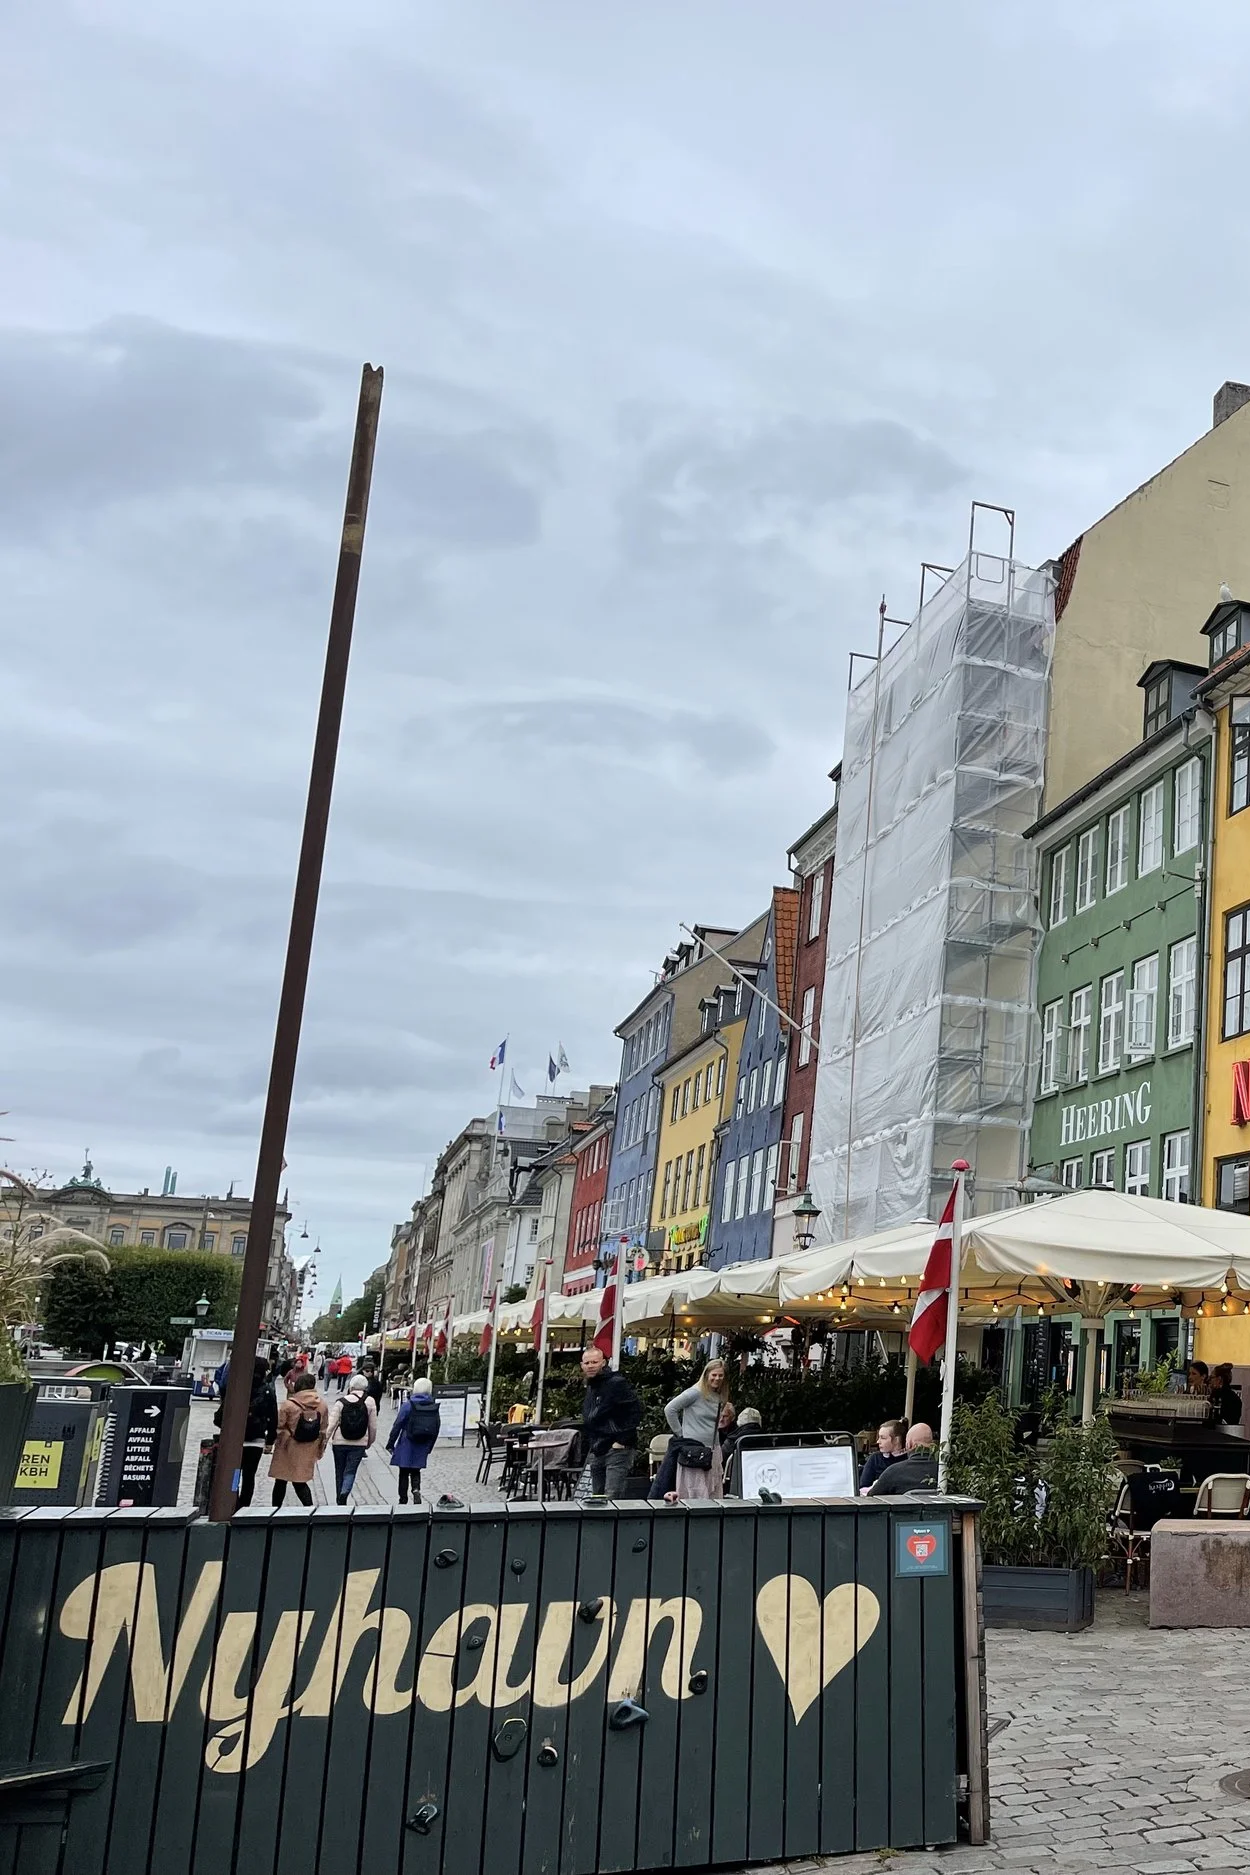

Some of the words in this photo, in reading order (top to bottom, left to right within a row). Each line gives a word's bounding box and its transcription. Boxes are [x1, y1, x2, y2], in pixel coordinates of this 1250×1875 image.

[1059, 1081, 1152, 1147] HEERING
[19, 1467, 49, 1477] KBH
[21, 1454, 50, 1464] REN
[60, 1561, 704, 1773] Nyhavn
